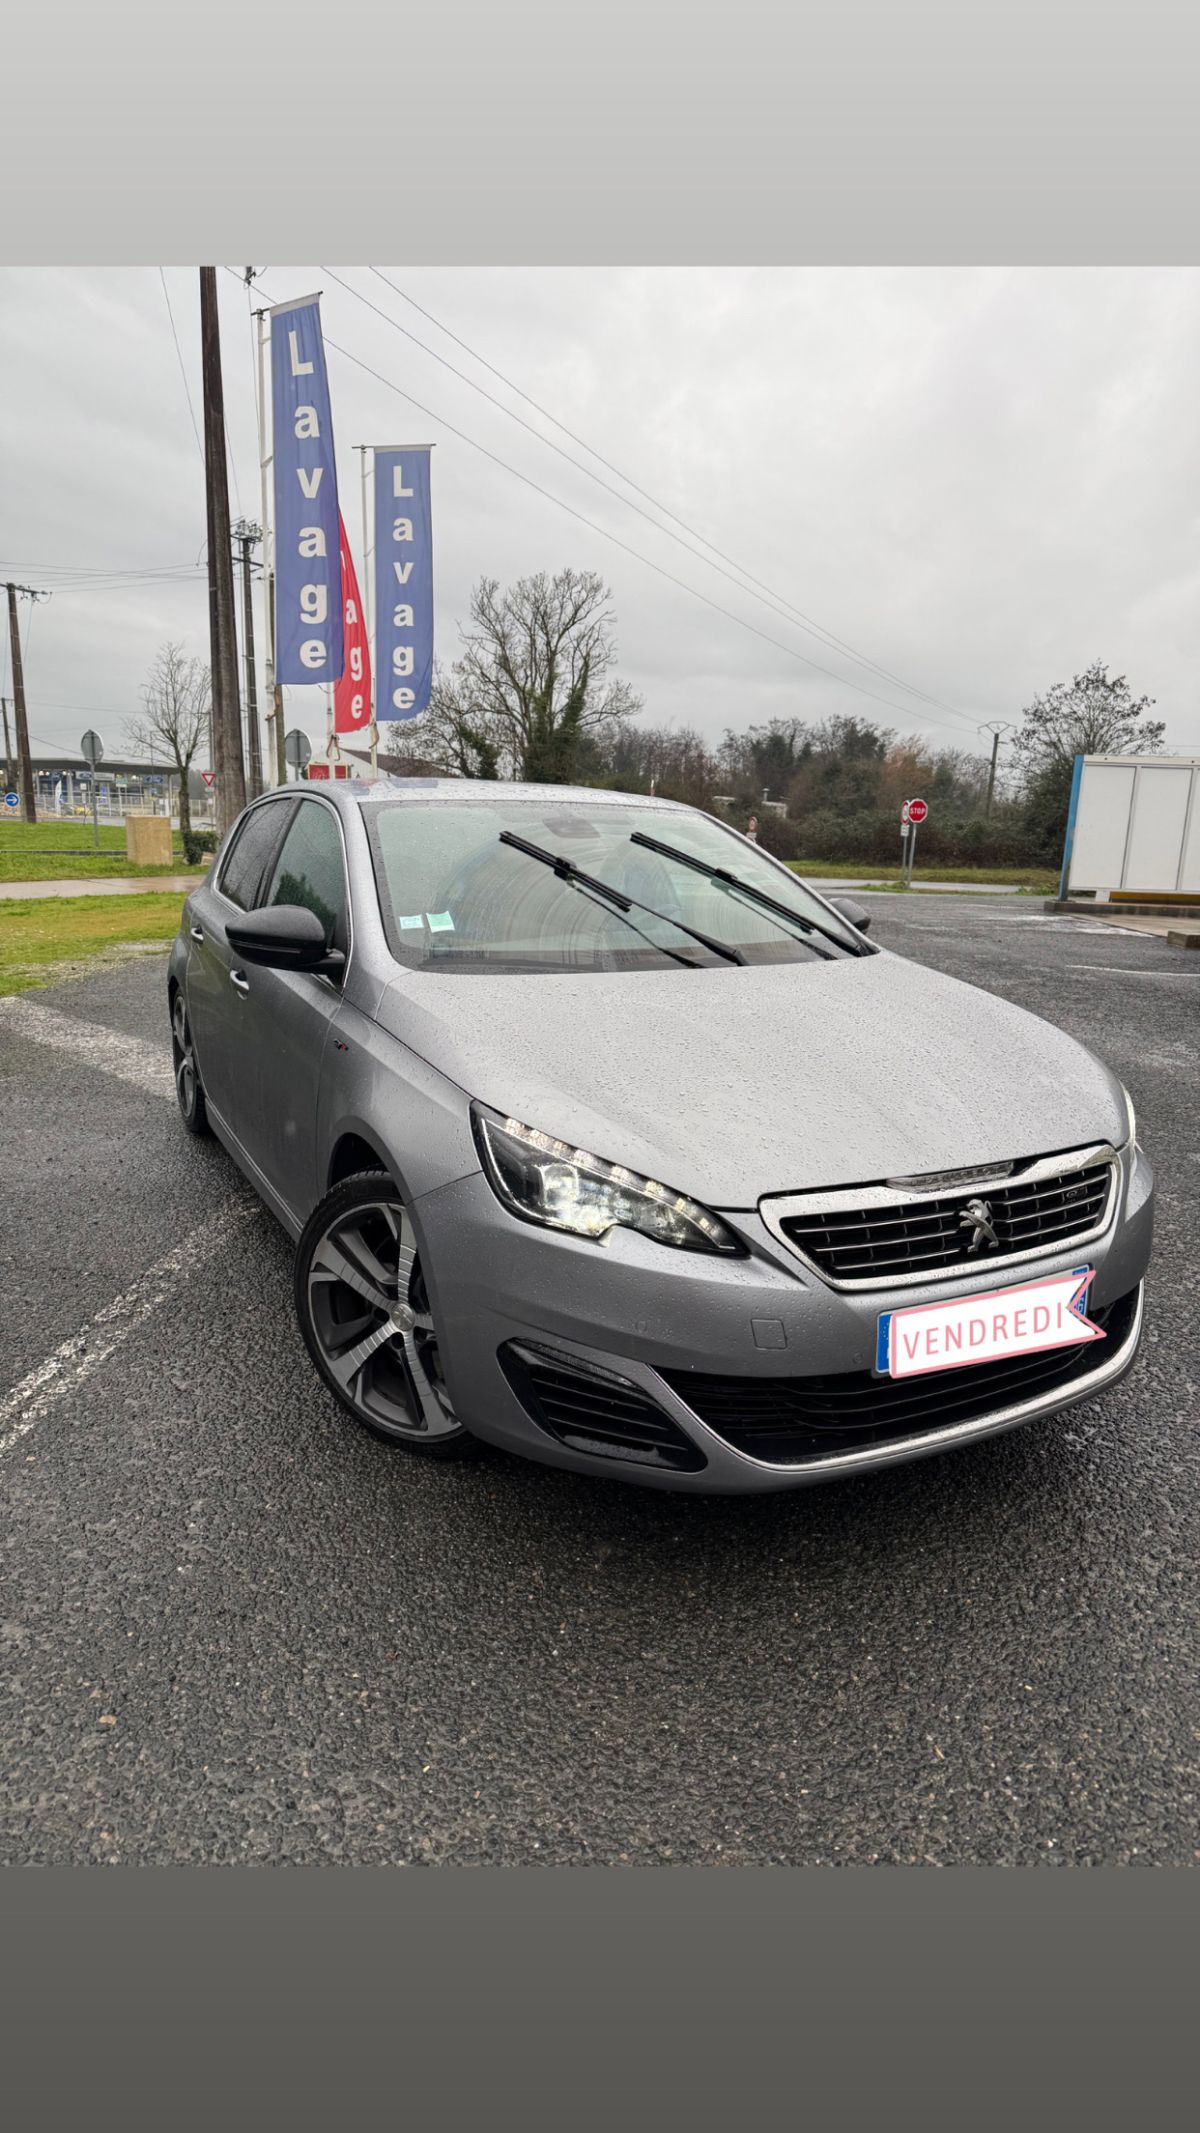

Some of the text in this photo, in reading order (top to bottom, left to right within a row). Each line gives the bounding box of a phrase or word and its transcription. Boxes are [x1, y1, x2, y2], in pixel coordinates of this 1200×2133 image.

[288, 330, 327, 669] Lavage
[392, 465, 415, 710] Lavage
[910, 807, 926, 815] STOP
